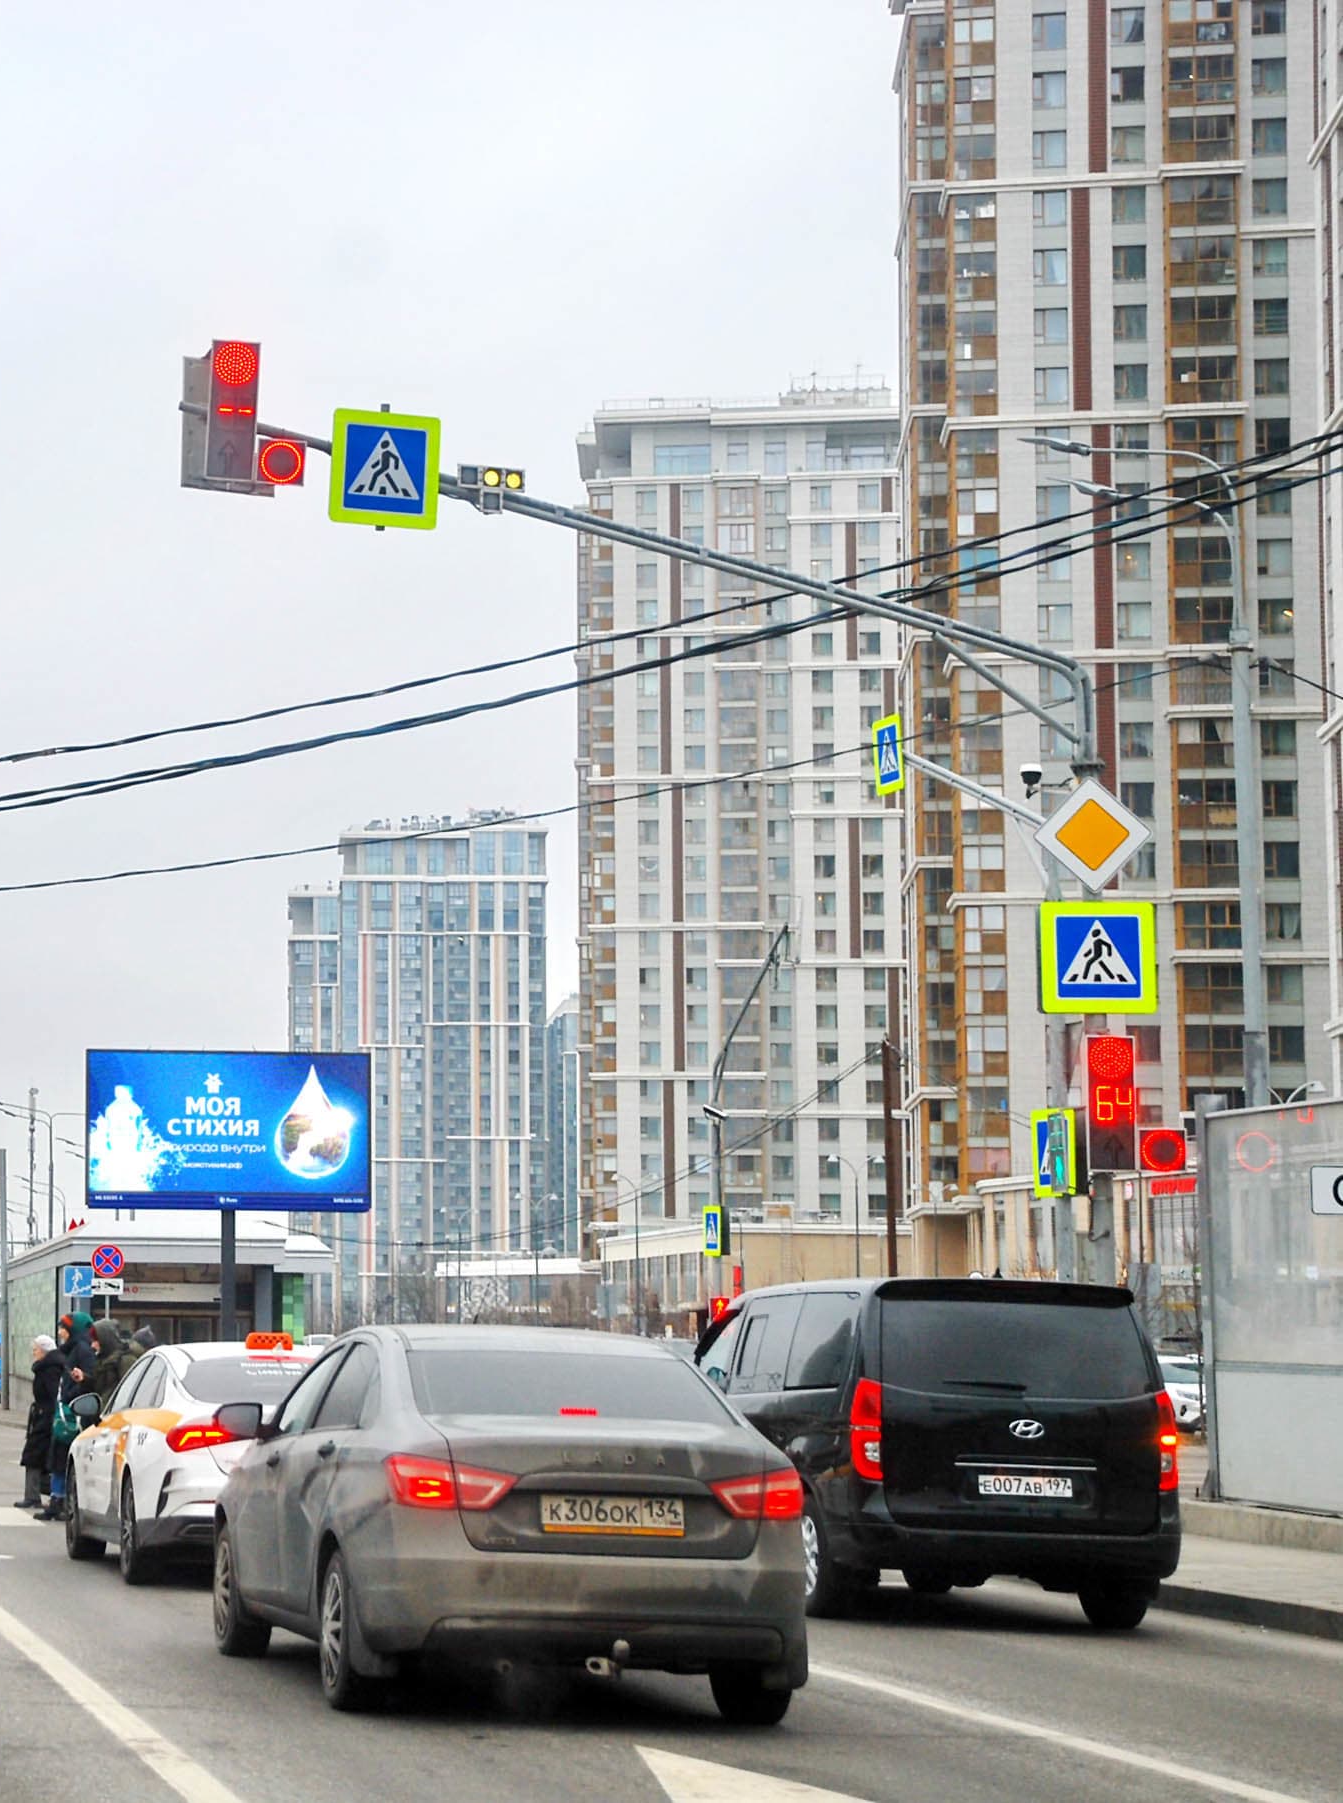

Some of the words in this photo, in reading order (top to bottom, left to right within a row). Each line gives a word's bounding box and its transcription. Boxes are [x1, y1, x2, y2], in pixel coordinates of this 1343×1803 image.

[185, 1096, 241, 1116] МОЯ
[1097, 1086, 1133, 1121] 64
[166, 1118, 260, 1136] СТИХИЯ
[220, 1143, 267, 1154] внутри
[563, 1451, 665, 1465] LADA
[1046, 1479, 1067, 1491] 197
[644, 1500, 680, 1518] 134
